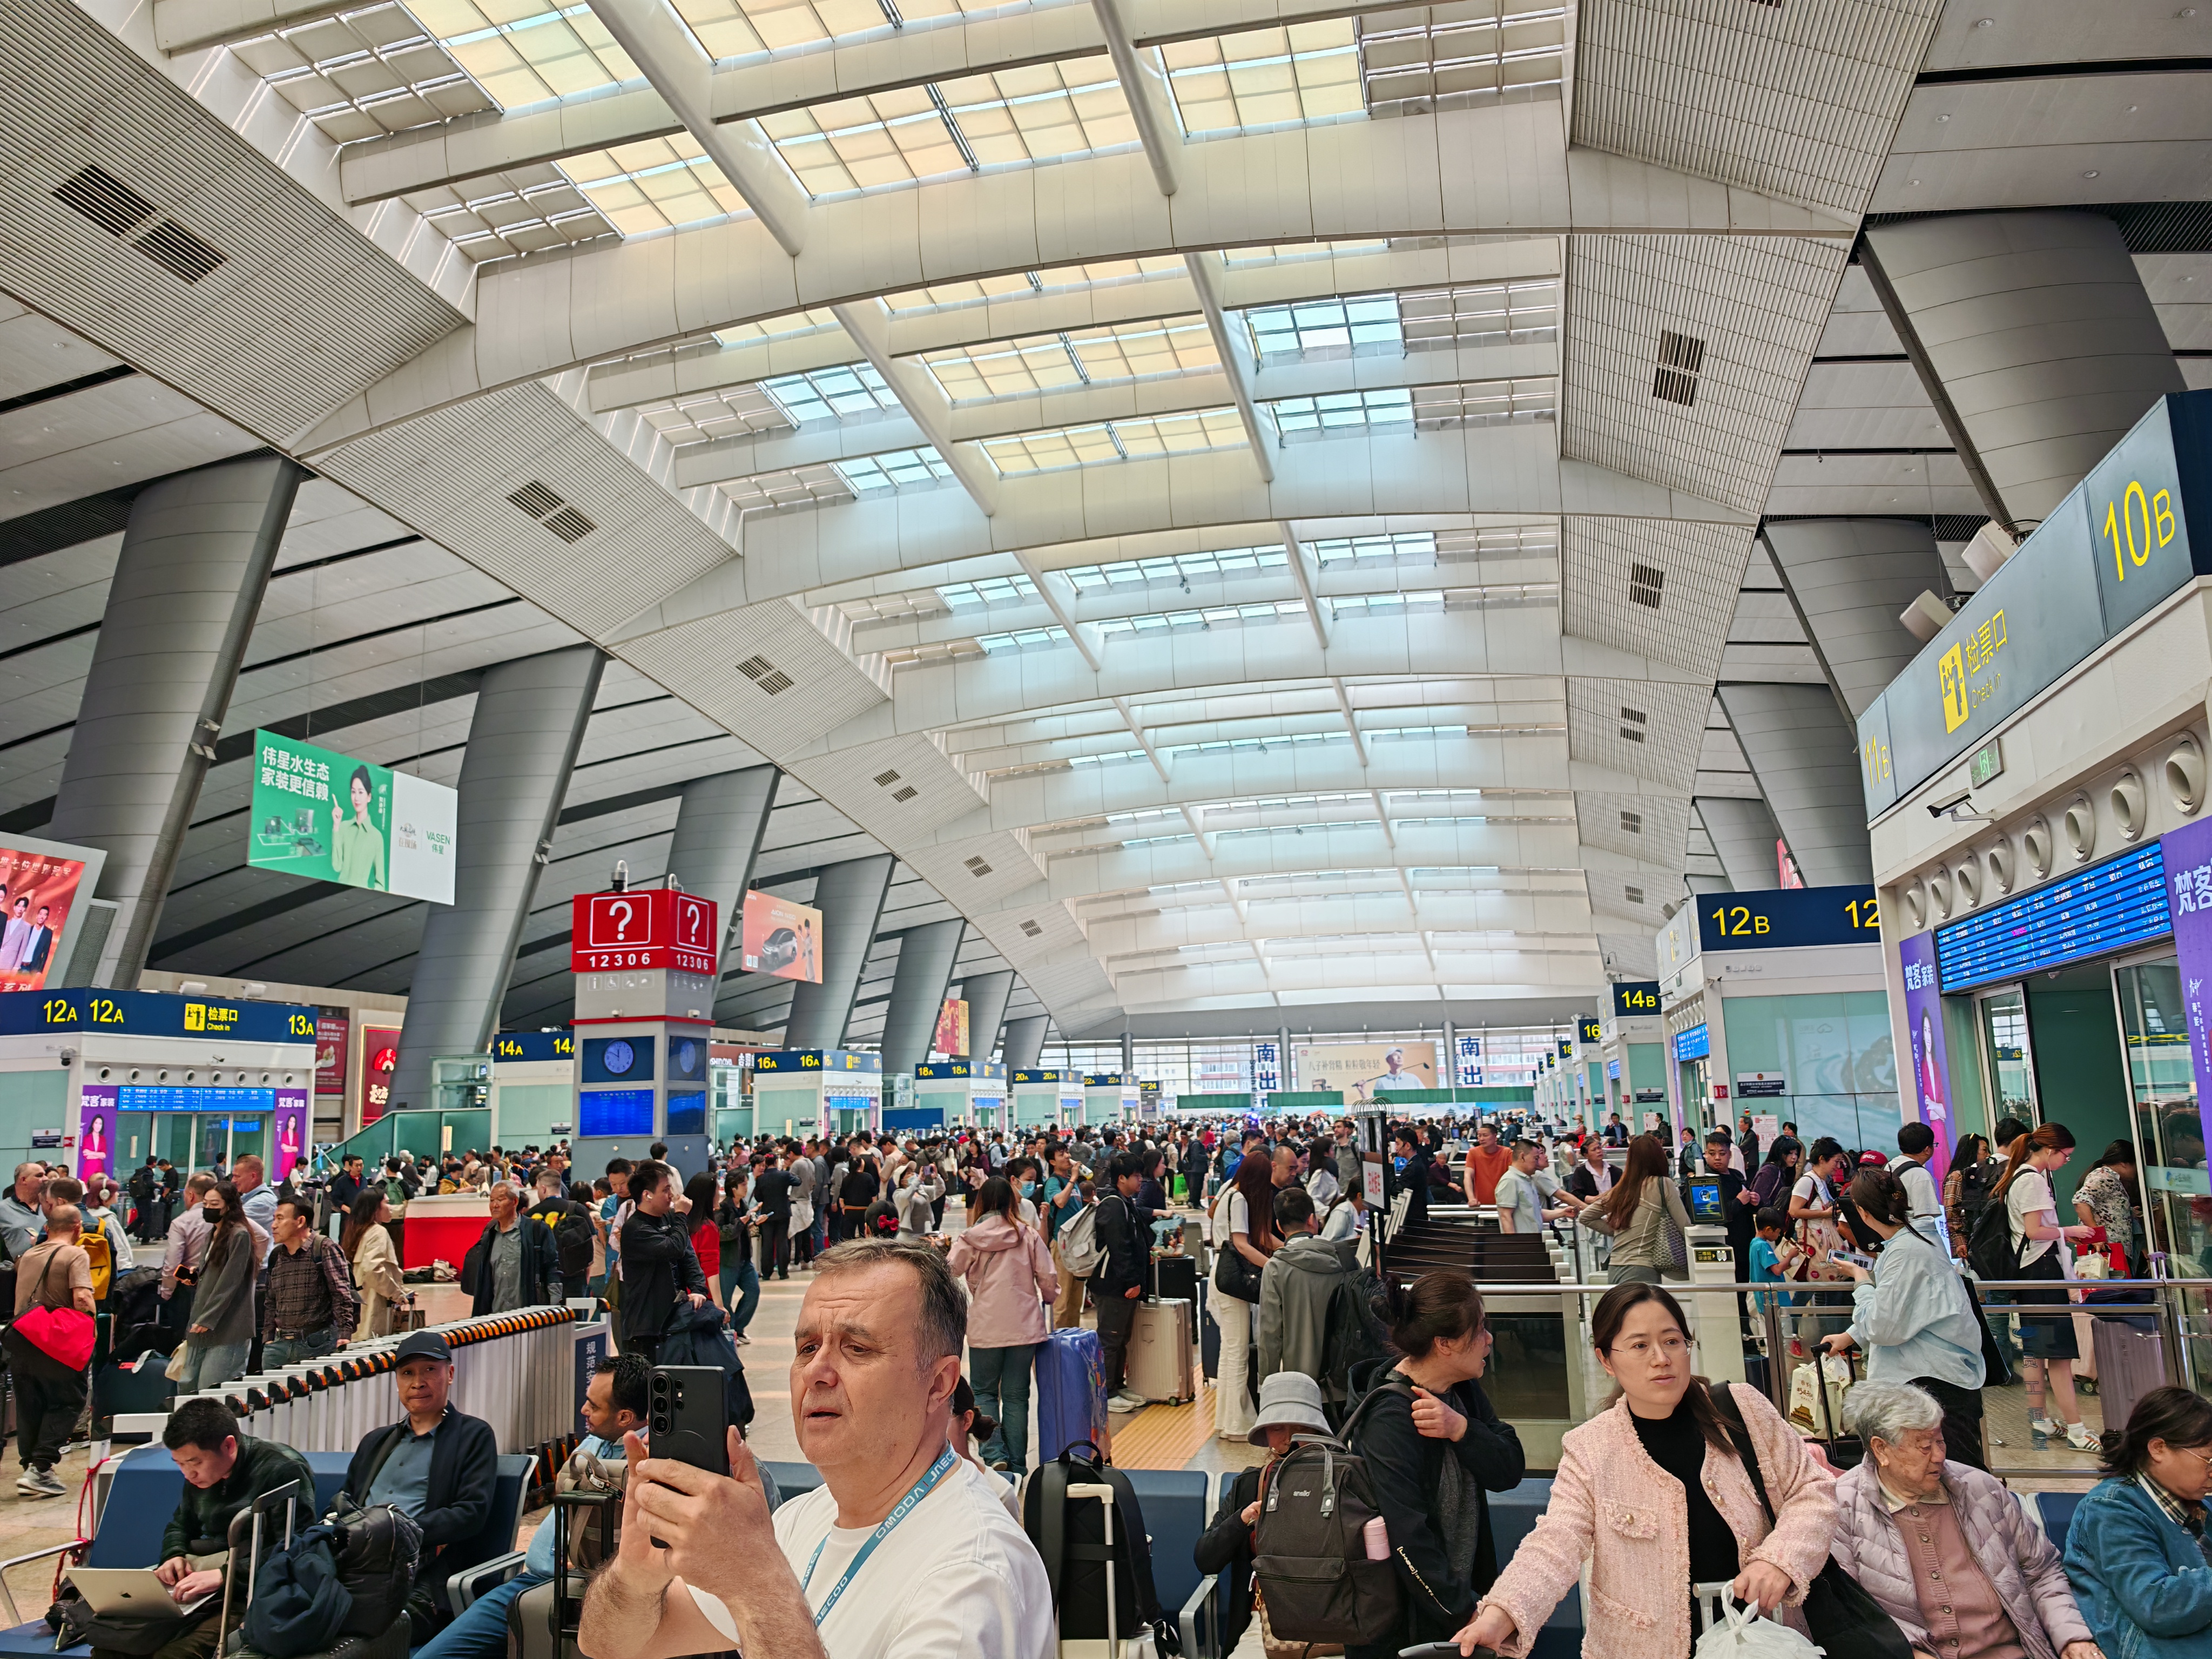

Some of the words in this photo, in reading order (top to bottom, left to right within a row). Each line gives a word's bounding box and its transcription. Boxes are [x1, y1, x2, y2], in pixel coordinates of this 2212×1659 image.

[2103, 481, 2175, 582] 10B
[1965, 609, 2007, 678] 检票口
[1971, 677, 1994, 709] Check
[1994, 671, 2002, 692] in
[262, 746, 329, 781] 伟星水生态
[1865, 733, 1890, 790] 11B
[261, 767, 329, 801] 家装更信赖
[426, 831, 450, 845] VASEN
[432, 844, 444, 855] 伟星
[1712, 907, 1770, 936] 12B
[1845, 899, 1879, 928] 12
[589, 953, 650, 968] 12306
[676, 954, 708, 970] 12306
[1905, 962, 1934, 992] 梵客家装
[1622, 990, 1656, 1008] 14B
[43, 1000, 77, 1023] 12A
[90, 999, 124, 1023] 12A
[208, 1007, 238, 1022] 检票口
[207, 1023, 224, 1031] Check
[288, 1015, 314, 1035] 13A
[1584, 1024, 1601, 1038] 16
[498, 1040, 523, 1056] 14A
[1562, 1044, 1572, 1054] 18
[757, 1057, 777, 1069] 16A
[800, 1055, 820, 1067] 16A
[952, 1066, 968, 1074] 18A
[1459, 1036, 1482, 1085] 南出
[918, 1067, 934, 1076] 18A
[1015, 1073, 1029, 1081] 20A
[1043, 1072, 1057, 1080] 20A
[930, 1448, 956, 1482] JAECO
[875, 1487, 925, 1539] OMODA
[815, 1576, 848, 1626] AECOO
